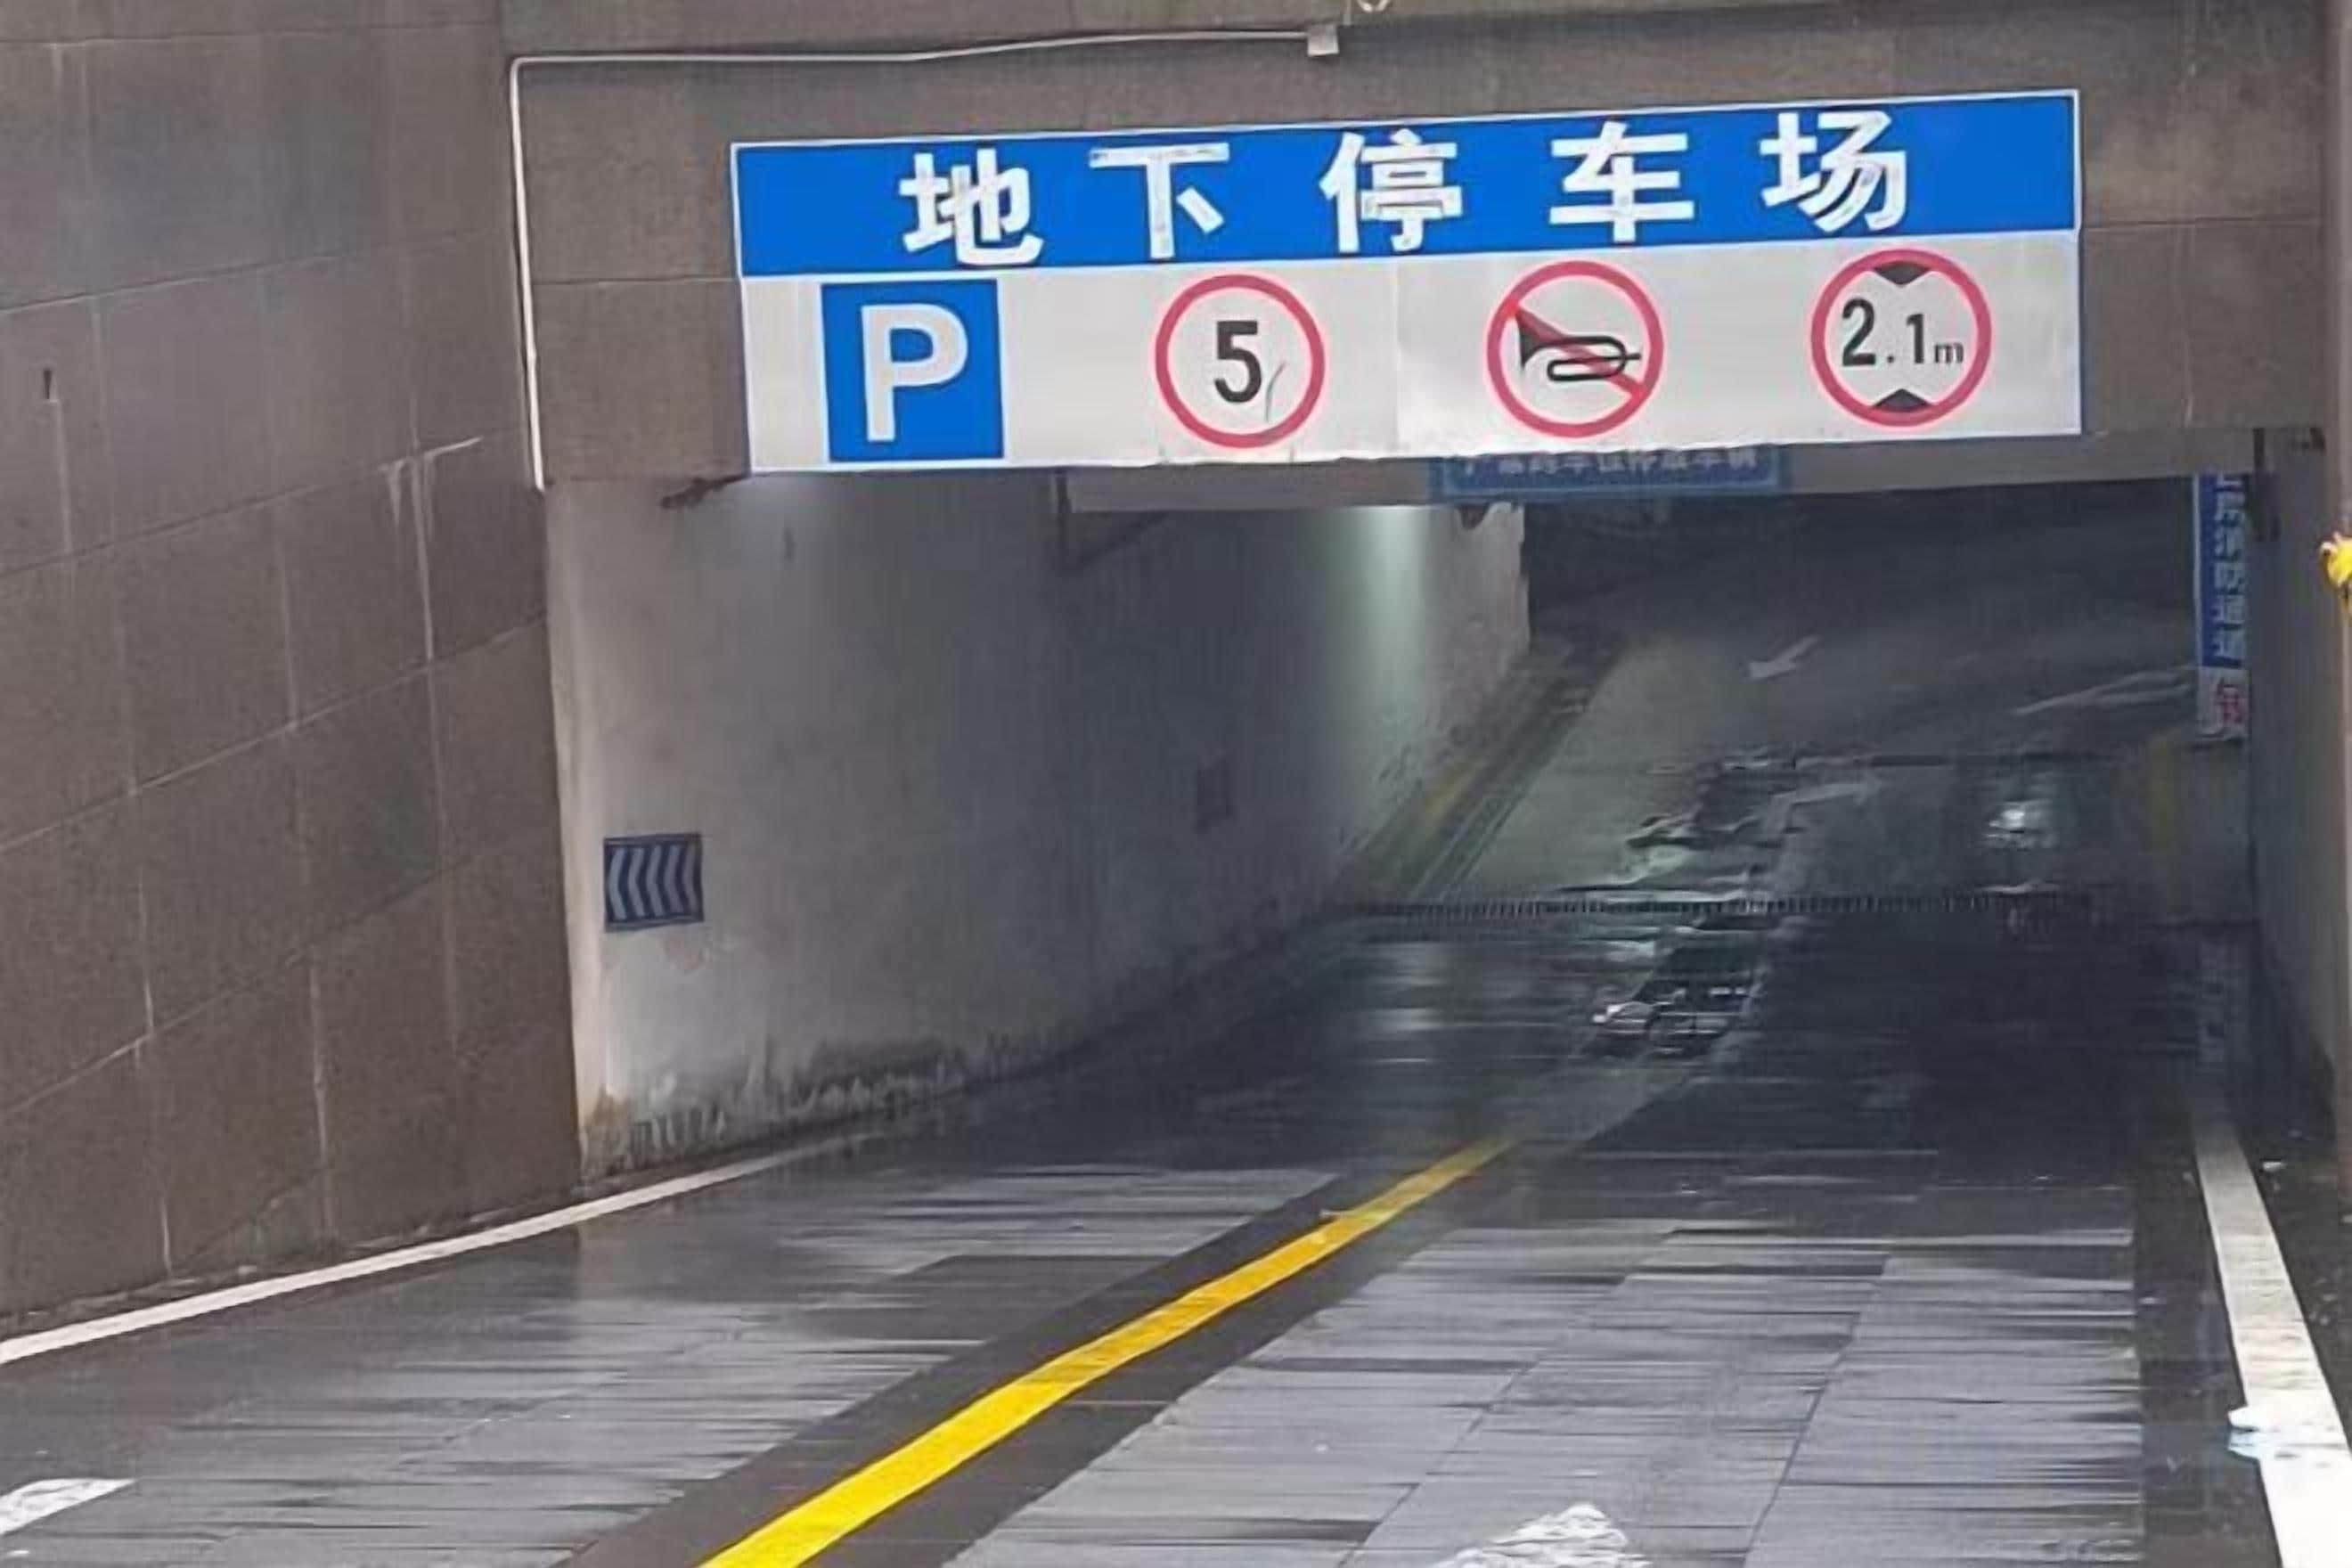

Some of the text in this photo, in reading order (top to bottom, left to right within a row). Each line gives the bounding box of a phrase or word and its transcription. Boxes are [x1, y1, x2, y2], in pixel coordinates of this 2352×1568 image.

[899, 111, 1907, 265] 地下停车场
[861, 303, 969, 443] P
[1213, 320, 1263, 404] 5
[1842, 298, 1964, 367] 2.1m
